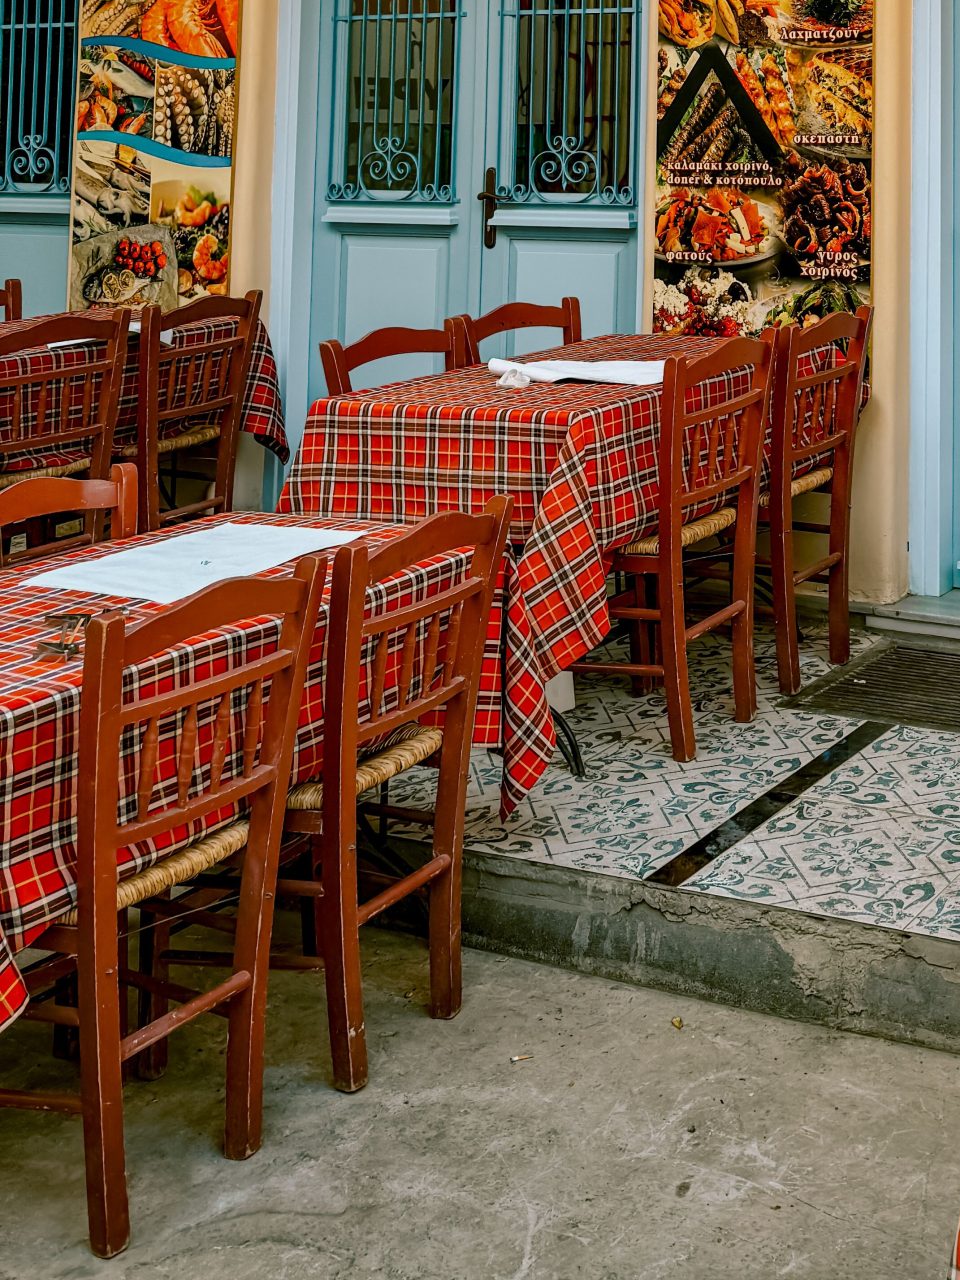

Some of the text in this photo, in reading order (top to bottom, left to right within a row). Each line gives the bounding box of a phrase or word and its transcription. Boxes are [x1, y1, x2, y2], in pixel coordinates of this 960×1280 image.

[780, 28, 860, 43] λαχματζούν
[793, 131, 860, 145] σκεπαστή
[667, 160, 723, 174] καλαμάκι
[667, 175, 782, 187] doner & κοτόπουλο
[665, 249, 713, 263] φατούς
[818, 249, 858, 264] γύρος
